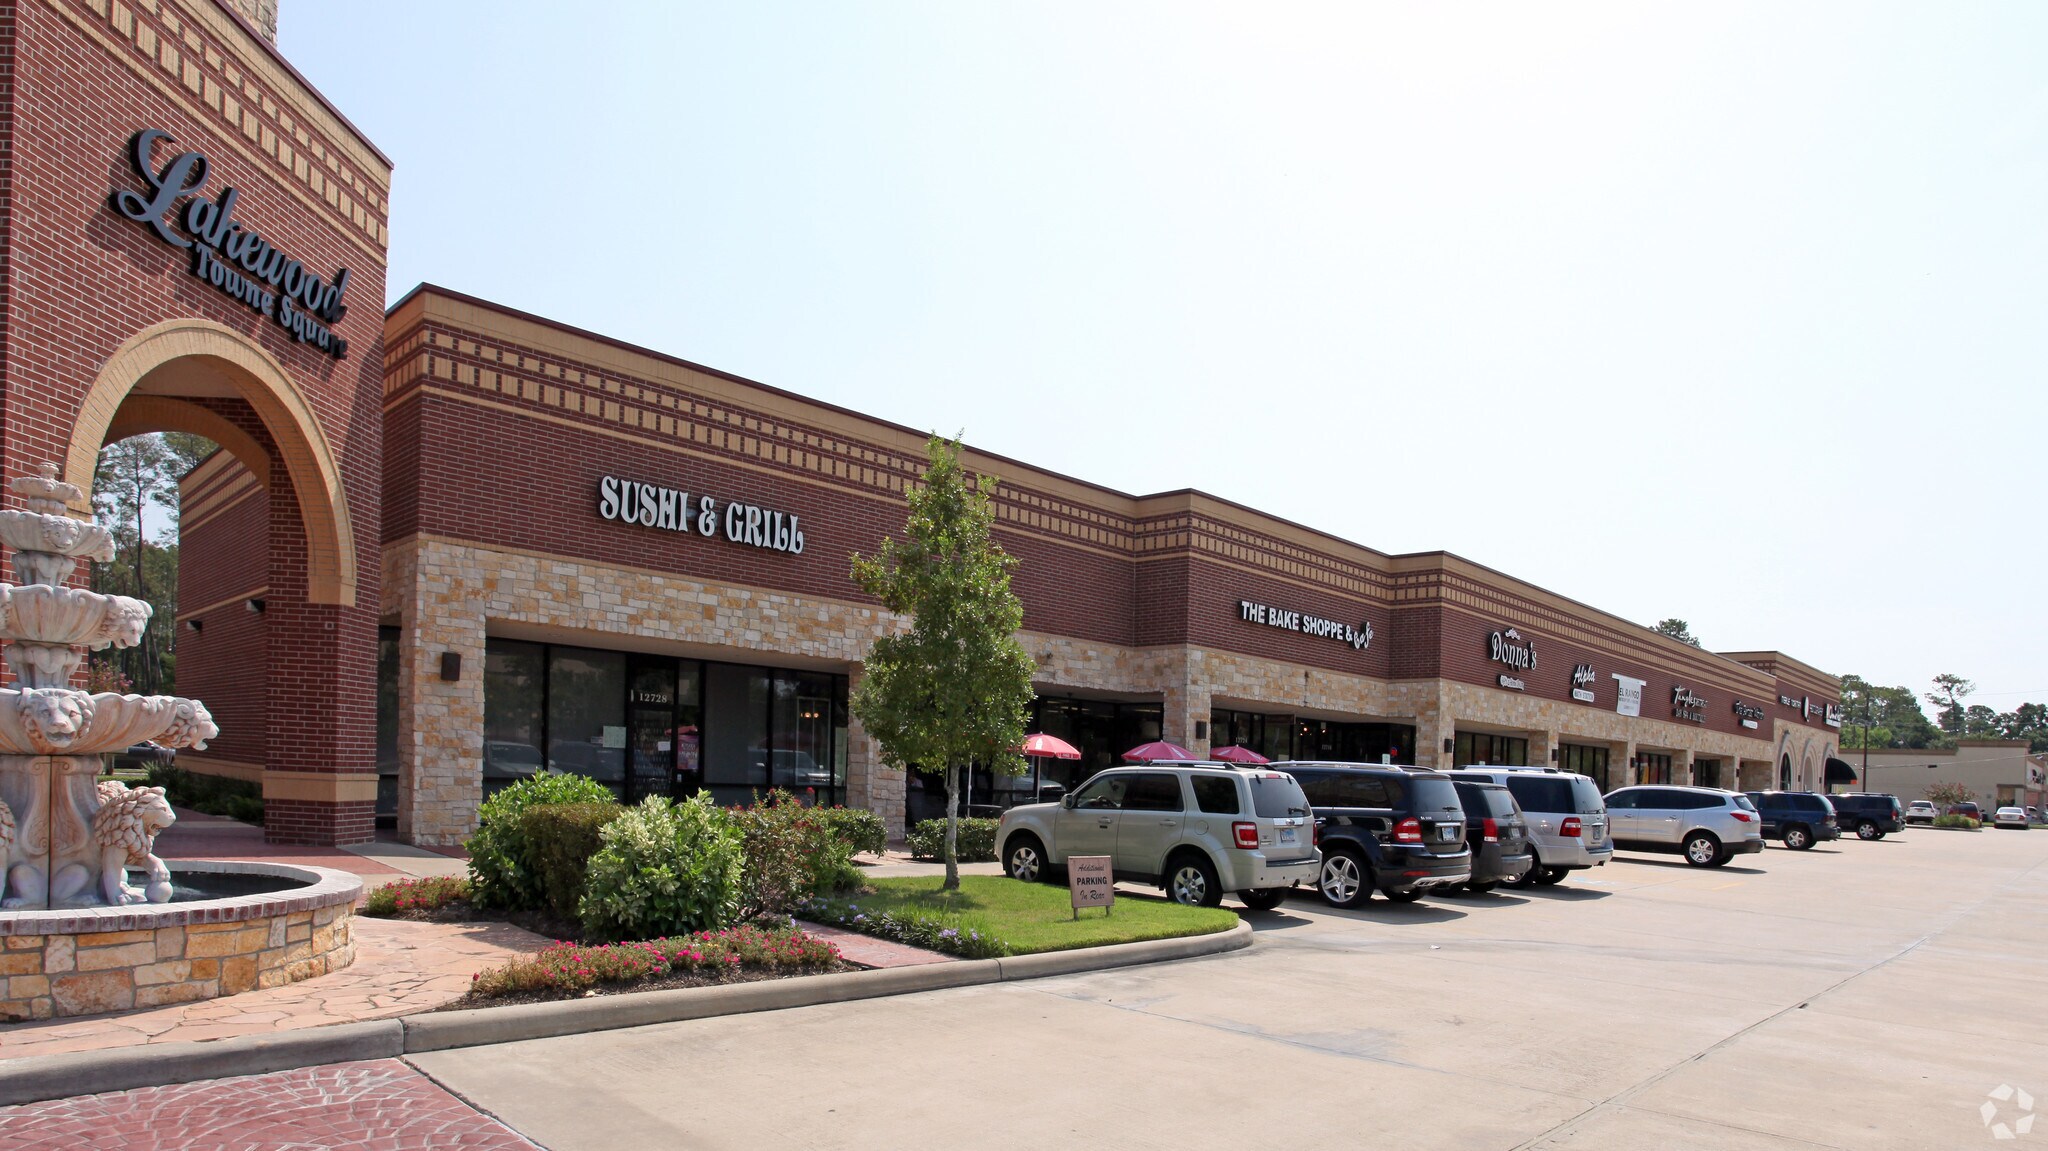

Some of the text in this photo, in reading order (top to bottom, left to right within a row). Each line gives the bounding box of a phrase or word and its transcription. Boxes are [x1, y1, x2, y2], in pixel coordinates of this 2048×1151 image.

[112, 128, 350, 323] Lakewood
[194, 242, 348, 358] Towne Square
[599, 475, 804, 555] SUSHI & GRILL
[1241, 600, 1266, 624] THE
[1268, 607, 1299, 631] BAKE
[1303, 615, 1343, 640] SHOPPE
[1345, 624, 1353, 642] &
[1491, 631, 1537, 671] Donna's
[1573, 664, 1596, 687] Alpha
[640, 693, 667, 703] 12728
[1077, 877, 1107, 885] PARKING
[1080, 890, 1105, 900] In Rear
